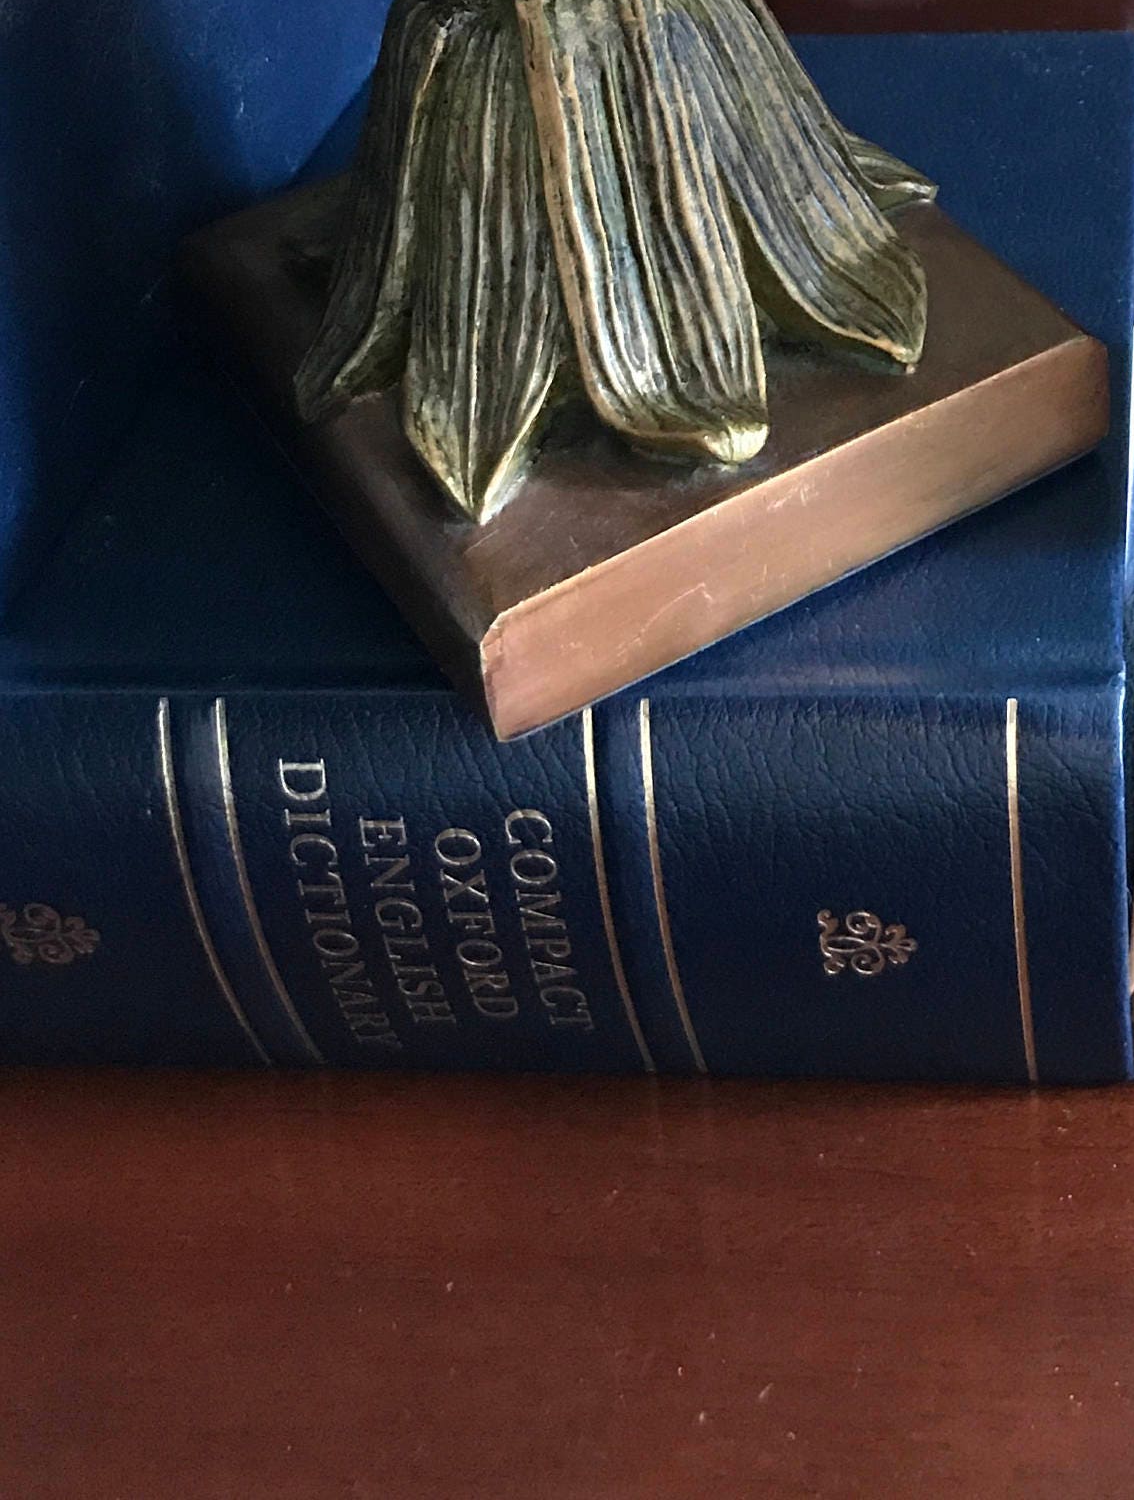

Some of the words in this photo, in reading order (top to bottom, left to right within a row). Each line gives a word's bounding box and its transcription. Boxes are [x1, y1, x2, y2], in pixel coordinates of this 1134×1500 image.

[278, 757, 403, 1050] DICTIONARY
[358, 815, 457, 1025] ENGLISH
[434, 827, 519, 1019] OXFORD
[505, 808, 594, 1032] COMPACT
